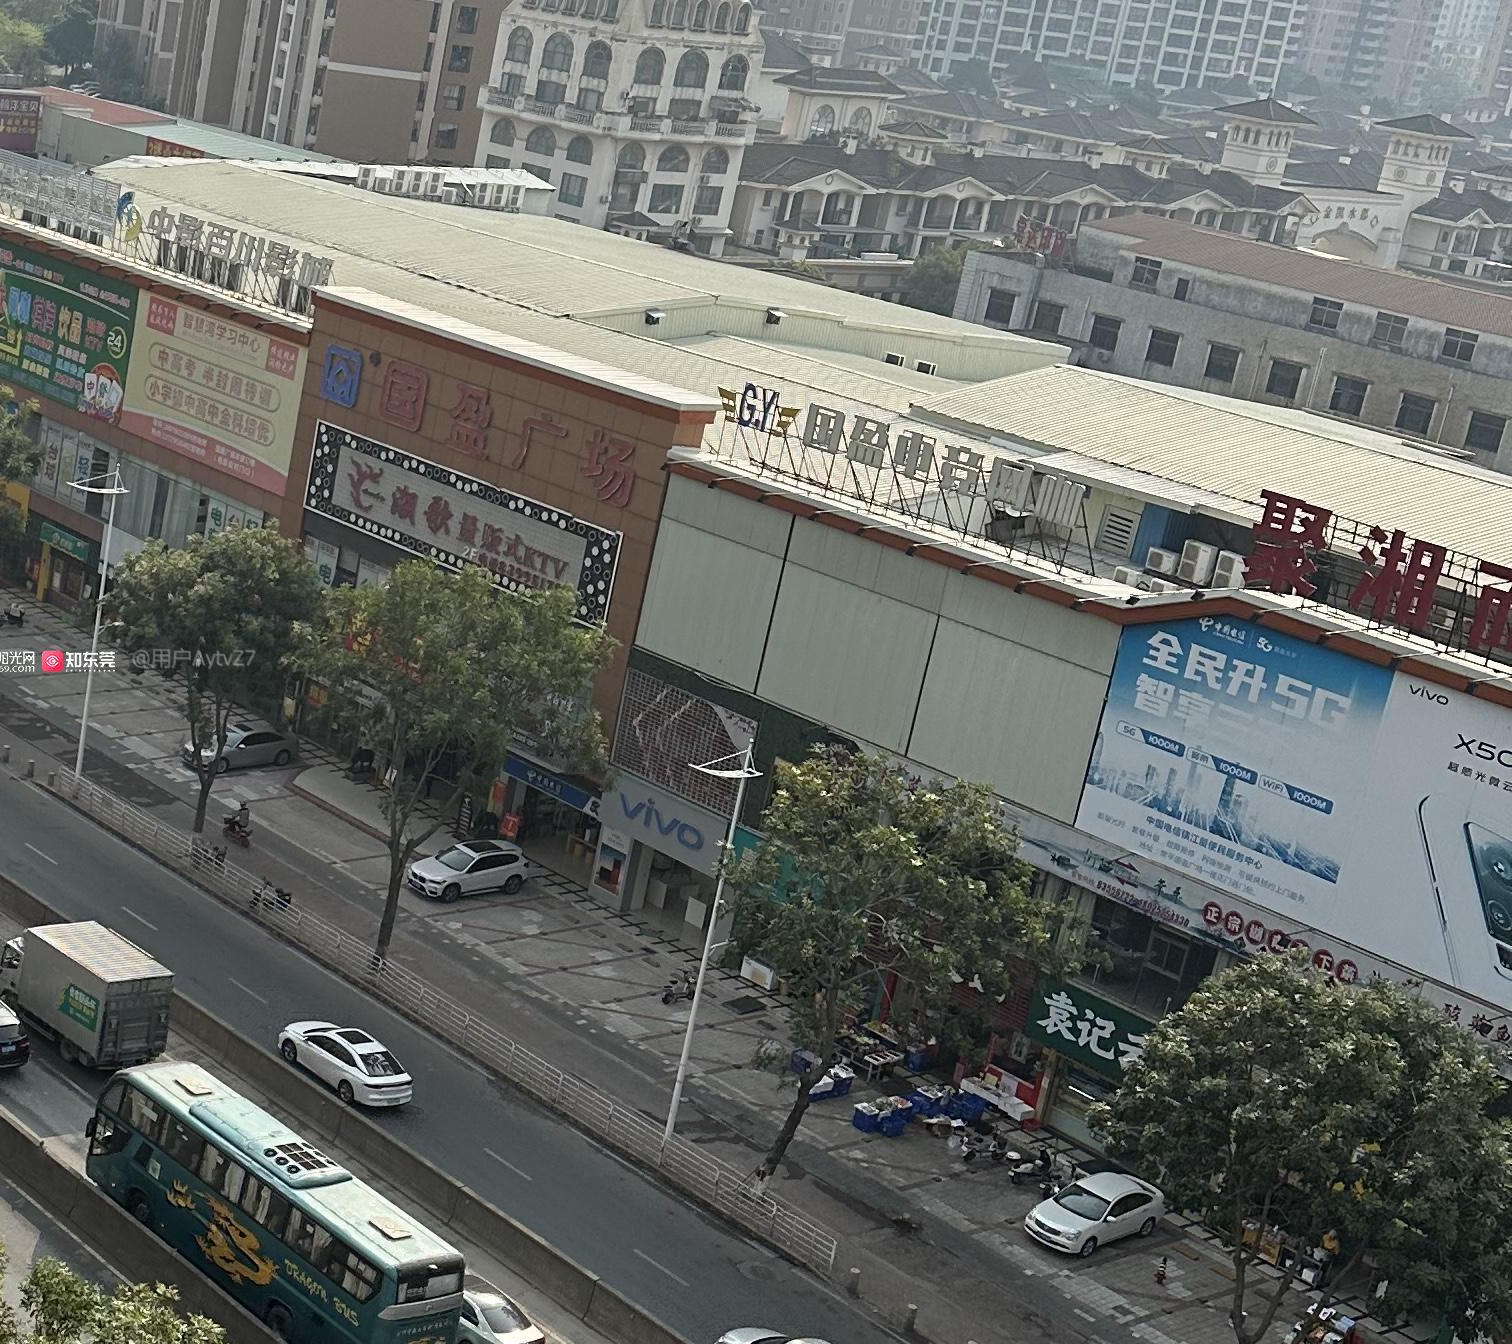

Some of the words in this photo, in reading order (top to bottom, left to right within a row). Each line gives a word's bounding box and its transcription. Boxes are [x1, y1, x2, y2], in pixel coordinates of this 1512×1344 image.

[147, 205, 336, 287] 中影百川影城
[107, 331, 123, 348] 24
[379, 359, 636, 508] 国盈广场
[1409, 683, 1449, 706] vivo
[1122, 725, 1137, 737] 5G
[1148, 735, 1180, 754] 1000M
[1219, 761, 1252, 782] 1000M
[1262, 778, 1285, 794] WiFi
[1293, 791, 1327, 810] 1000M
[619, 791, 704, 851] vivo
[332, 1296, 360, 1328] BUS
